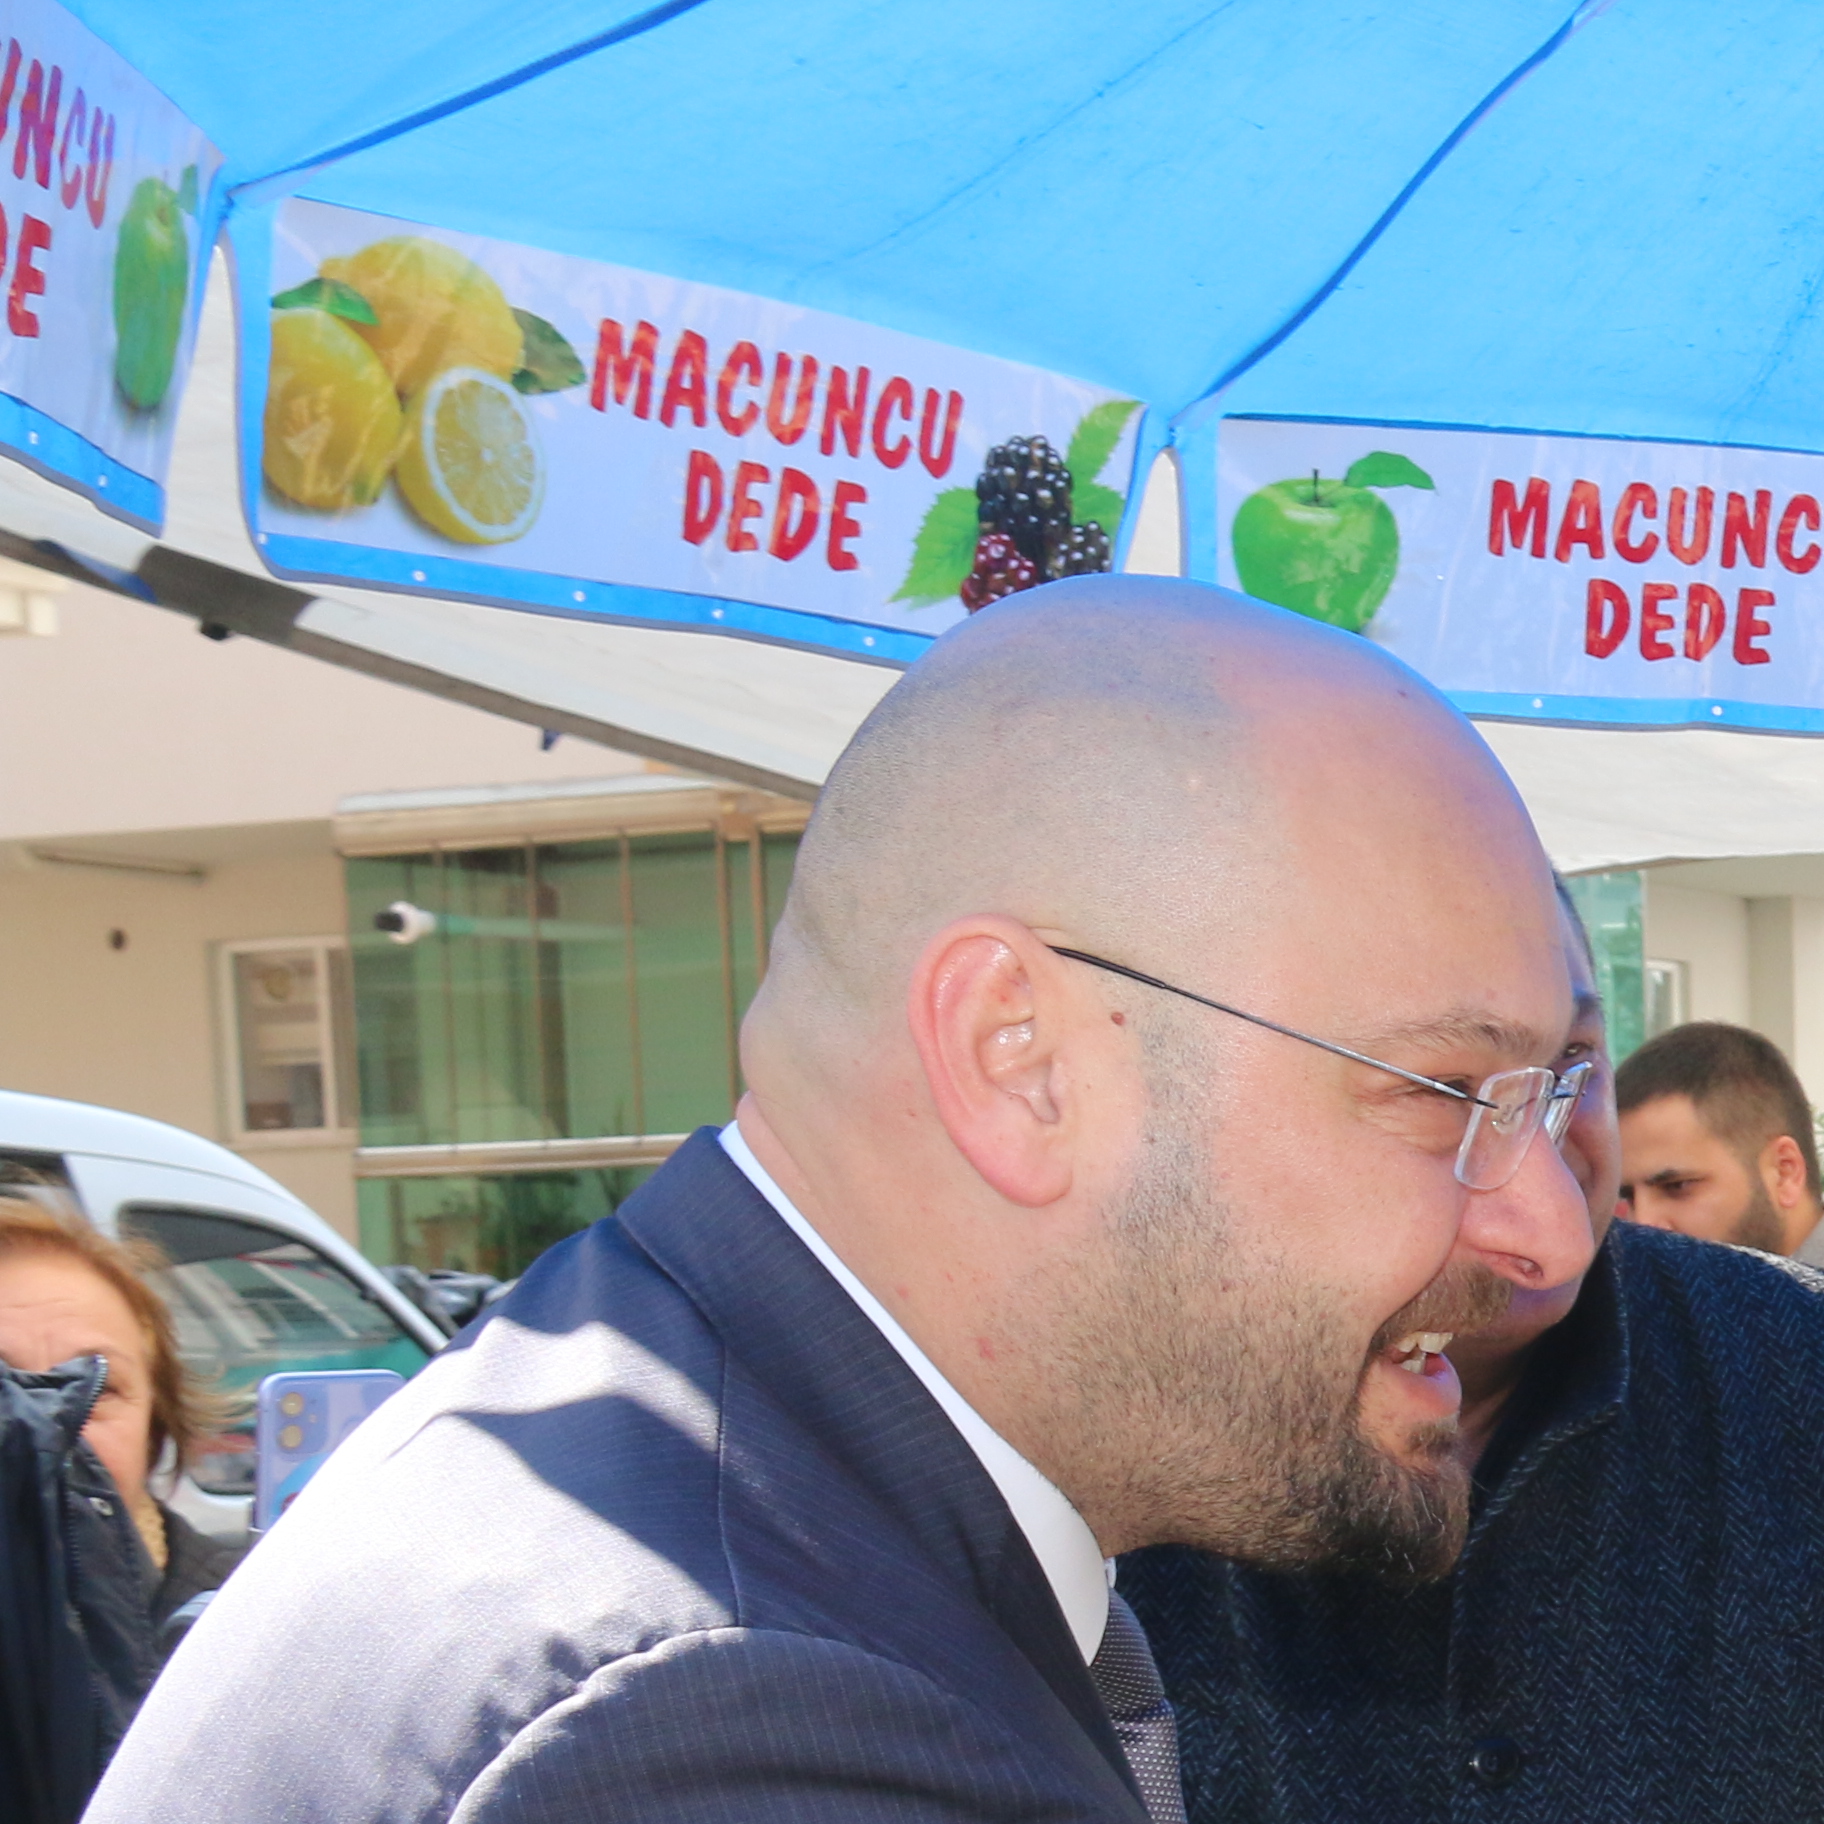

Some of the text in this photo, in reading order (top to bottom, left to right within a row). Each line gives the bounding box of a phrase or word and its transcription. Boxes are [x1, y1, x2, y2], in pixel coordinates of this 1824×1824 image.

[590, 317, 964, 478] MACUNCU
[682, 449, 868, 571] DEDE
[1584, 578, 1776, 665] DEDE
